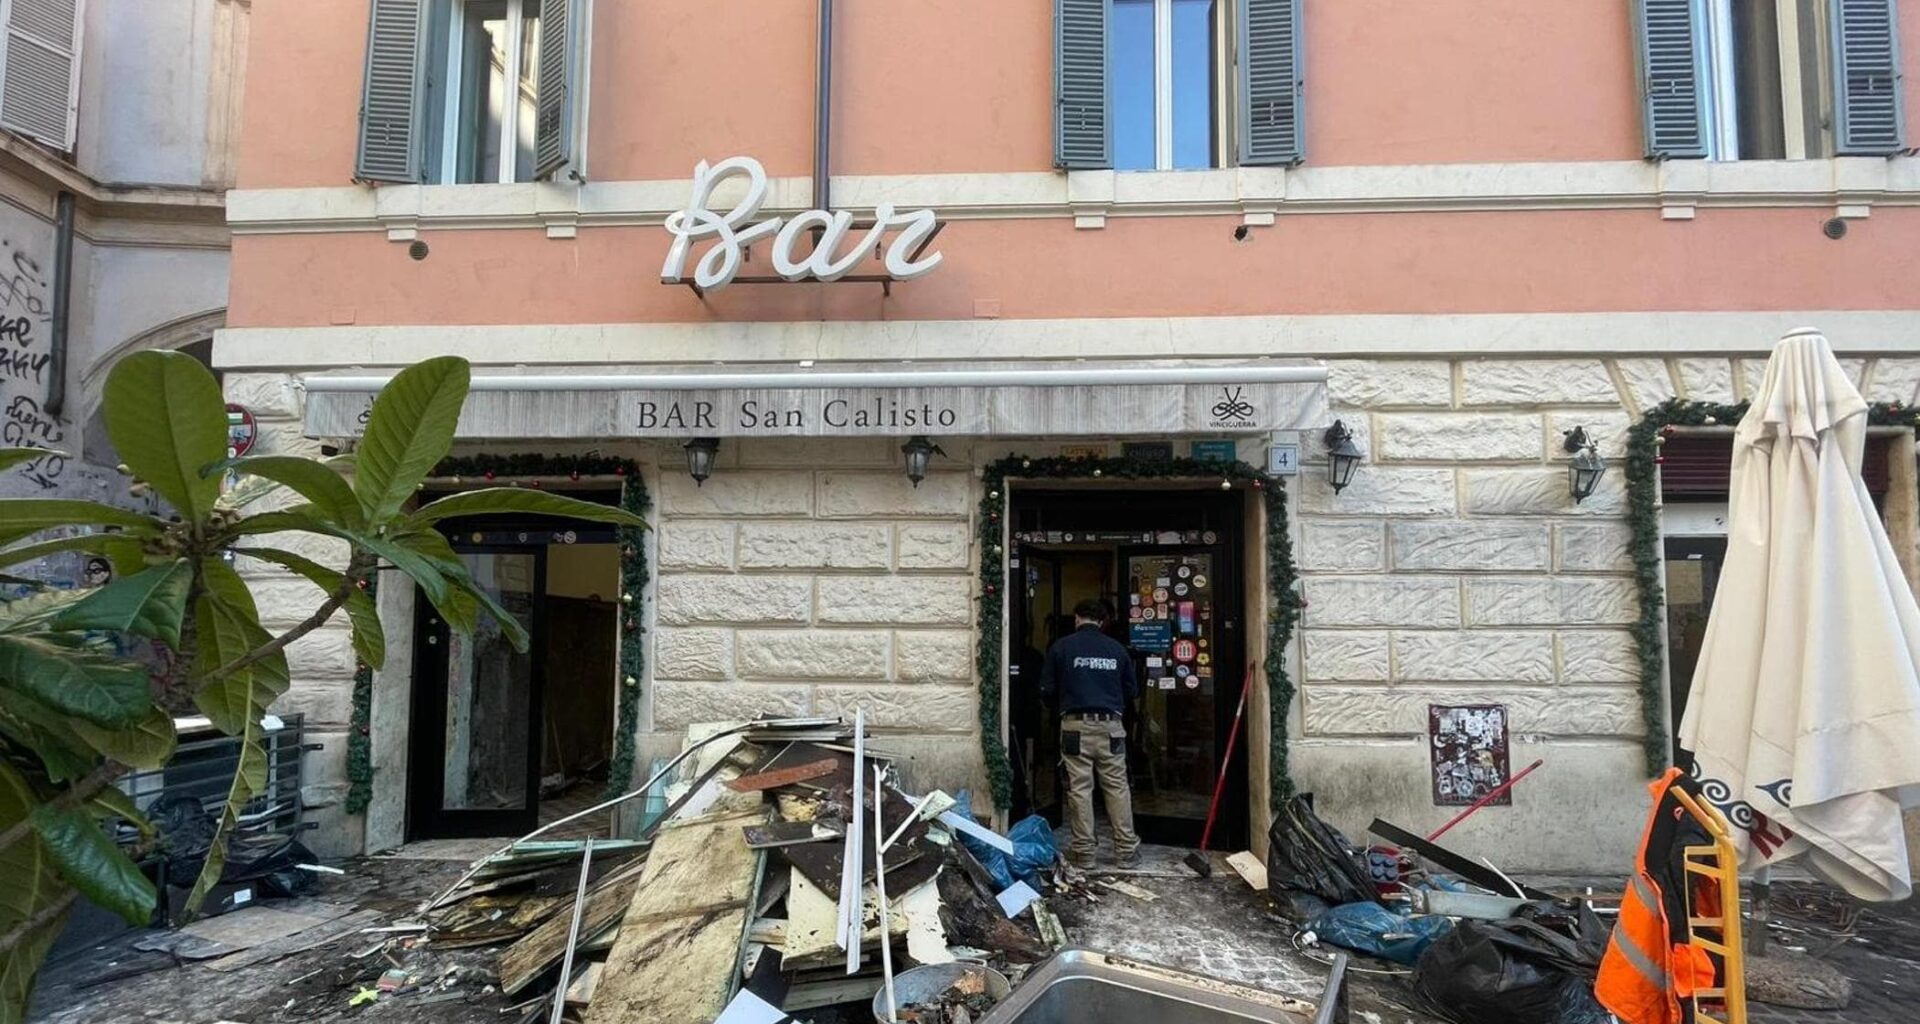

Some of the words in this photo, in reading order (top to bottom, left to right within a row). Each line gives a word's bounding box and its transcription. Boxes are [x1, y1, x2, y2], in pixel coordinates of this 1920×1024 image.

[661, 156, 943, 290] Bar
[637, 401, 716, 429] BAR
[740, 400, 804, 428] San
[823, 397, 957, 428] Calisto
[1279, 452, 1288, 467] 4
